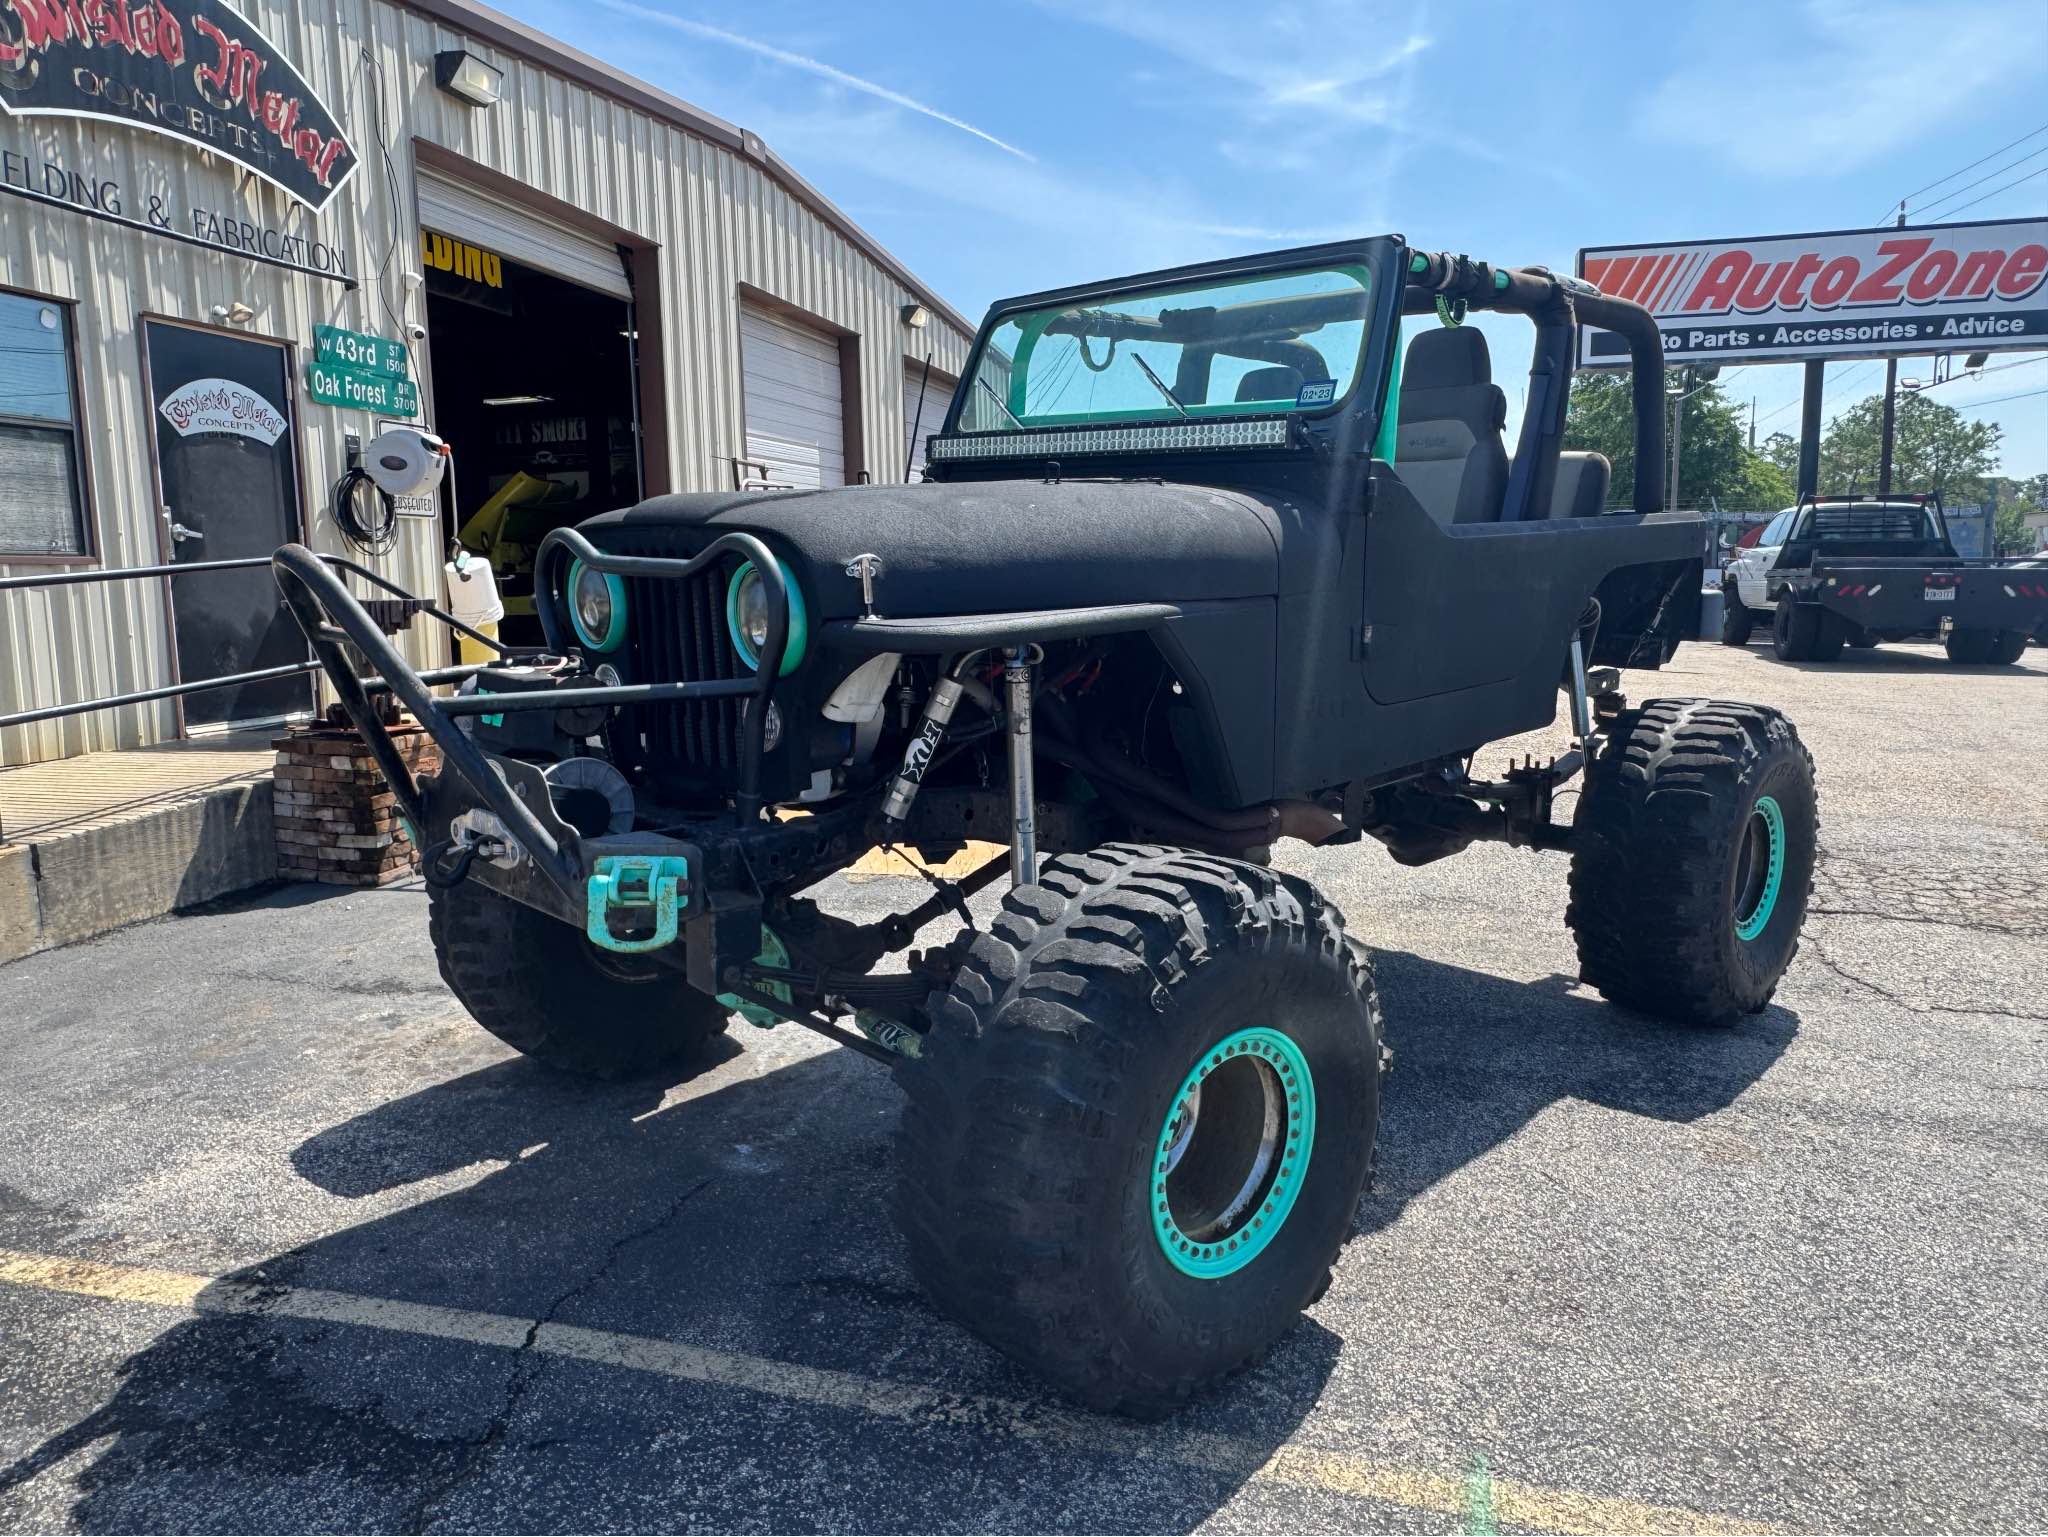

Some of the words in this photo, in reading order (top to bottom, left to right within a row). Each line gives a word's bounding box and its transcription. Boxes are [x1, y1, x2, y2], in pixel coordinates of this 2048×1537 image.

[193, 14, 347, 189] Metal
[147, 195, 173, 230] &
[191, 208, 347, 277] FABRICATION
[1684, 237, 2048, 314] AutoZone
[1688, 329, 1750, 349] Parts
[1772, 323, 1918, 345] Accessories
[1941, 316, 2026, 337] Advice
[320, 337, 331, 351] W
[335, 335, 377, 366] 43rd
[388, 344, 400, 357] ST
[385, 359, 406, 375] 1500
[314, 369, 341, 398] Oak
[344, 375, 387, 406] Forest
[398, 382, 410, 395] DR
[393, 396, 417, 412] 3700
[197, 417, 256, 431] CONCEPTS
[899, 719, 944, 782] FOX
